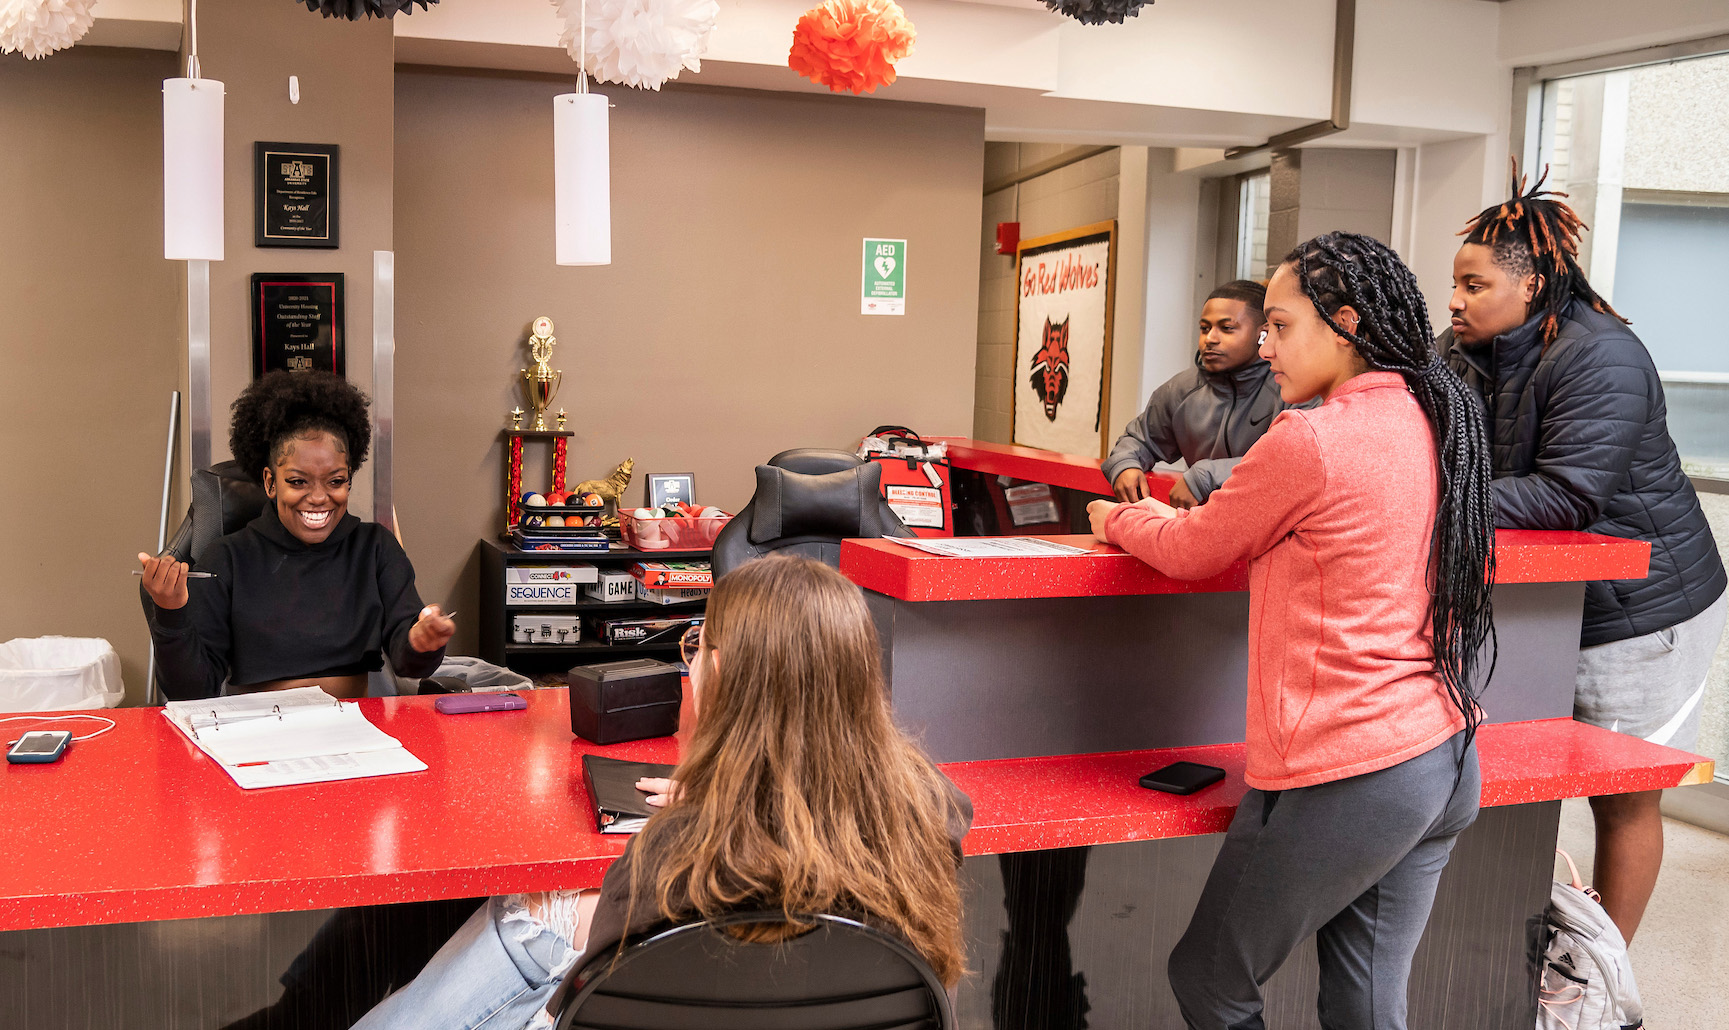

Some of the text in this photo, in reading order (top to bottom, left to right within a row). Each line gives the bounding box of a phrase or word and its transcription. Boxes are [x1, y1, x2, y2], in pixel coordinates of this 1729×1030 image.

[876, 244, 895, 256] AED
[1024, 252, 1098, 297] Go Red Wolves
[284, 343, 315, 352] Kays Hall
[671, 573, 711, 583] MONOPOLY
[510, 587, 571, 599] SEQUENCE
[608, 581, 633, 596] GAME
[614, 627, 647, 638] Risk
